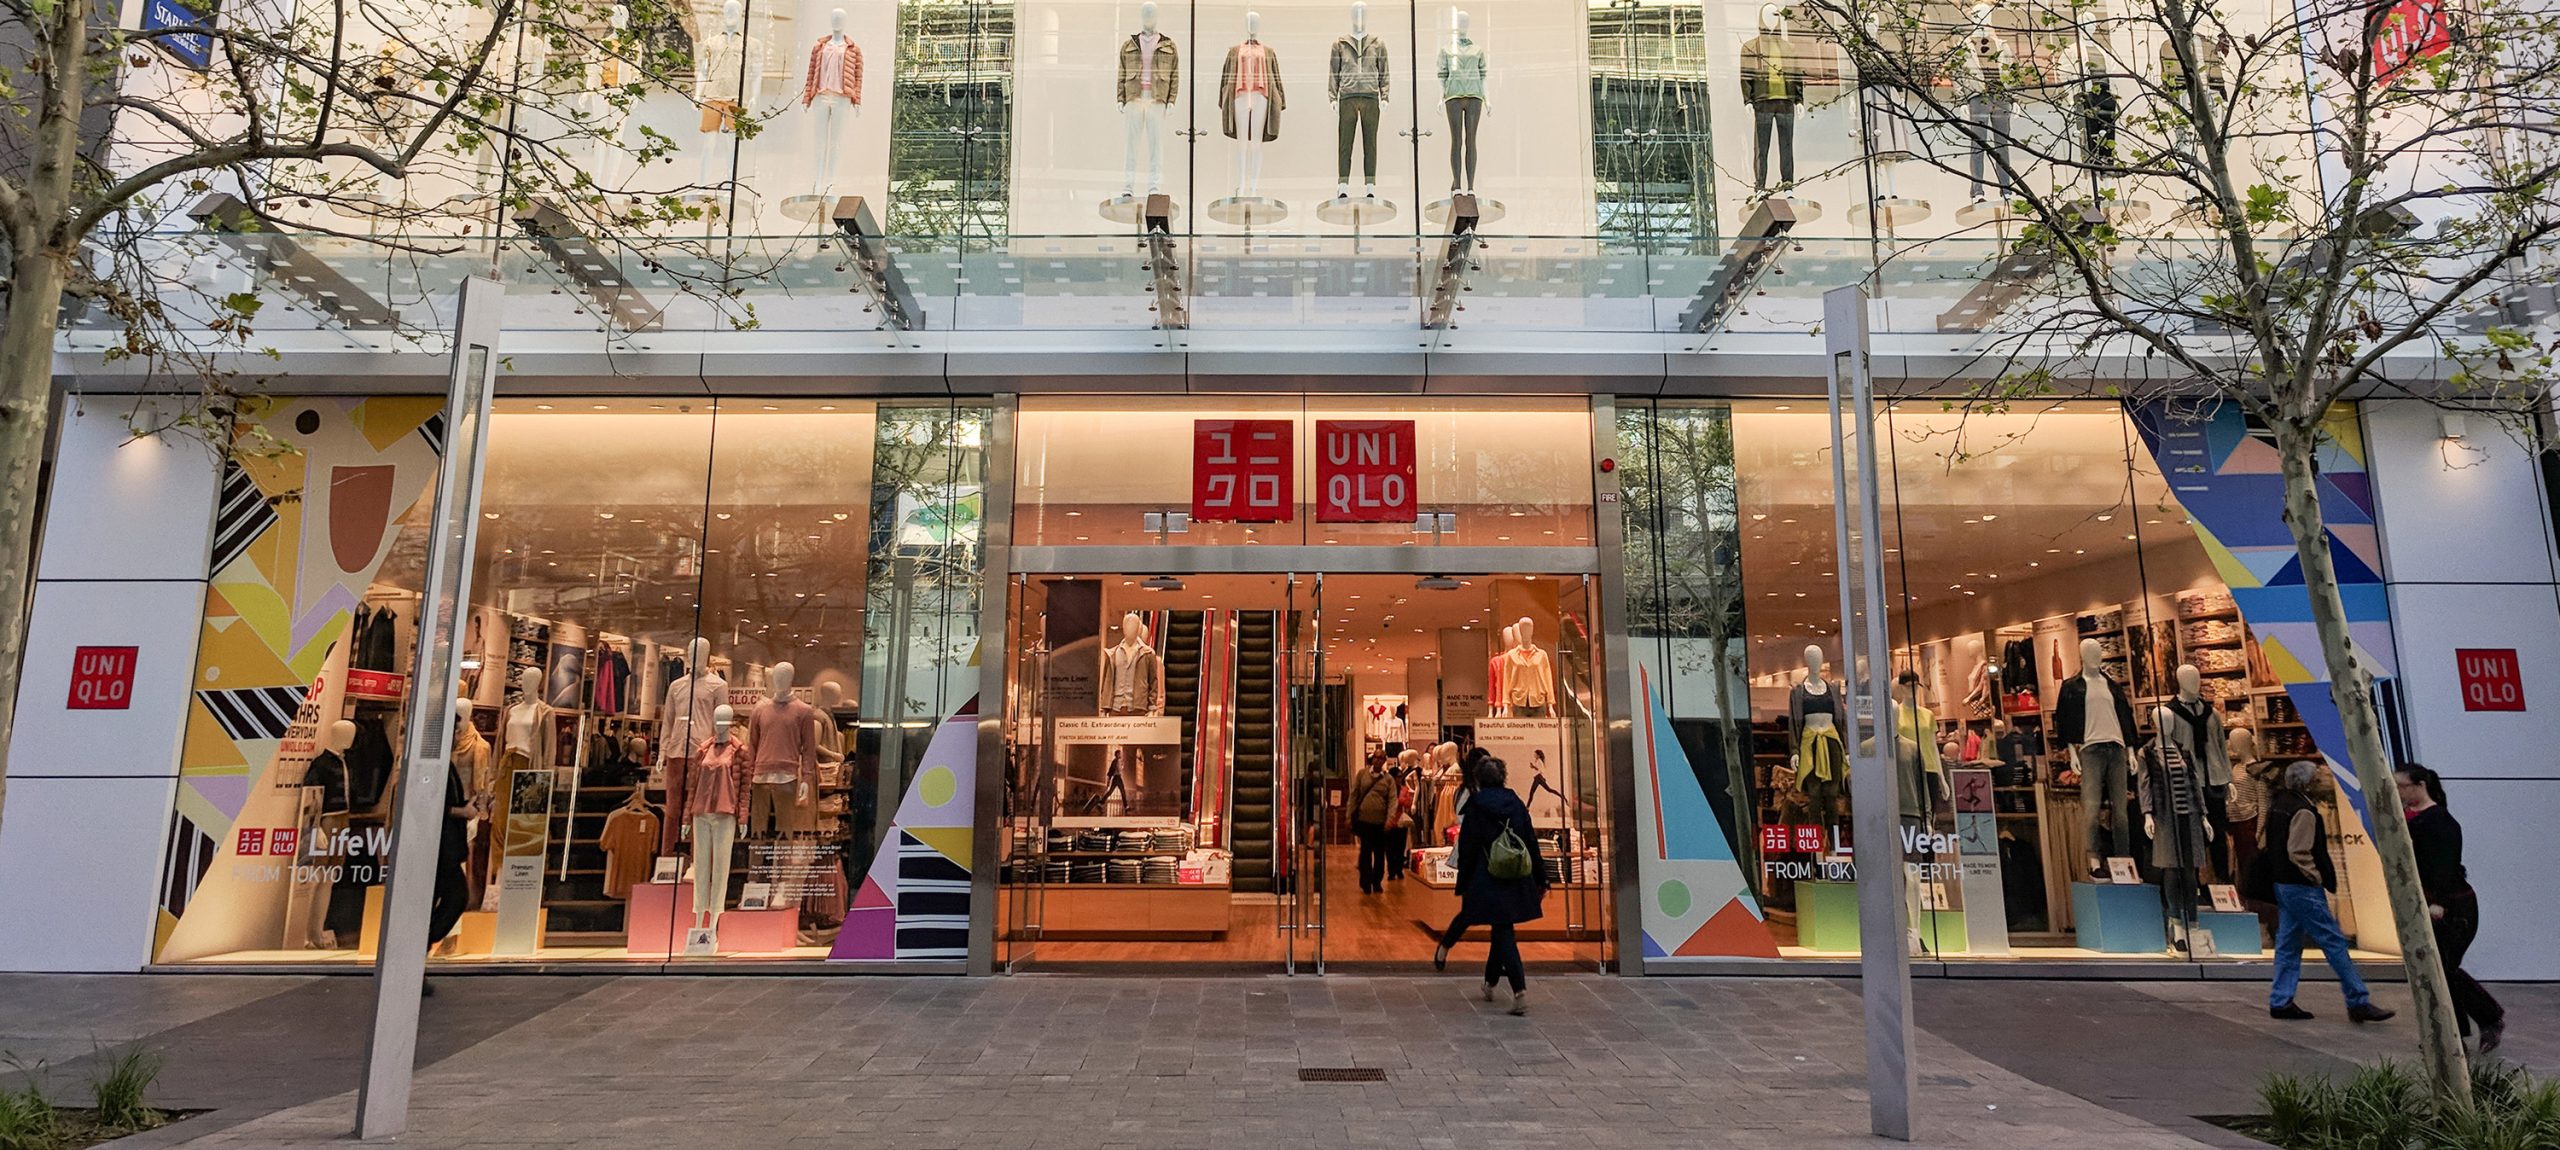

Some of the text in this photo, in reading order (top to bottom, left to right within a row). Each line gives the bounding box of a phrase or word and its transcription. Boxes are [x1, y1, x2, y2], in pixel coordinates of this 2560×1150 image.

[1208, 432, 1279, 465] ユニ
[1328, 432, 1397, 466] UNI
[1204, 474, 1279, 507] クロ
[1328, 474, 1405, 514] QLO
[81, 655, 125, 675] UNI
[2465, 657, 2508, 678] UNI
[77, 680, 125, 704] QLO
[2470, 682, 2516, 707] QLO
[275, 831, 294, 841] UNI
[308, 827, 394, 857] LifeW
[1798, 828, 1817, 838] UNI
[273, 842, 295, 853] QLO
[1799, 838, 1820, 850] QLO
[288, 865, 343, 883] TOKYO
[350, 865, 372, 883] TO
[1765, 861, 1965, 880] FROM TOKY PERTH
